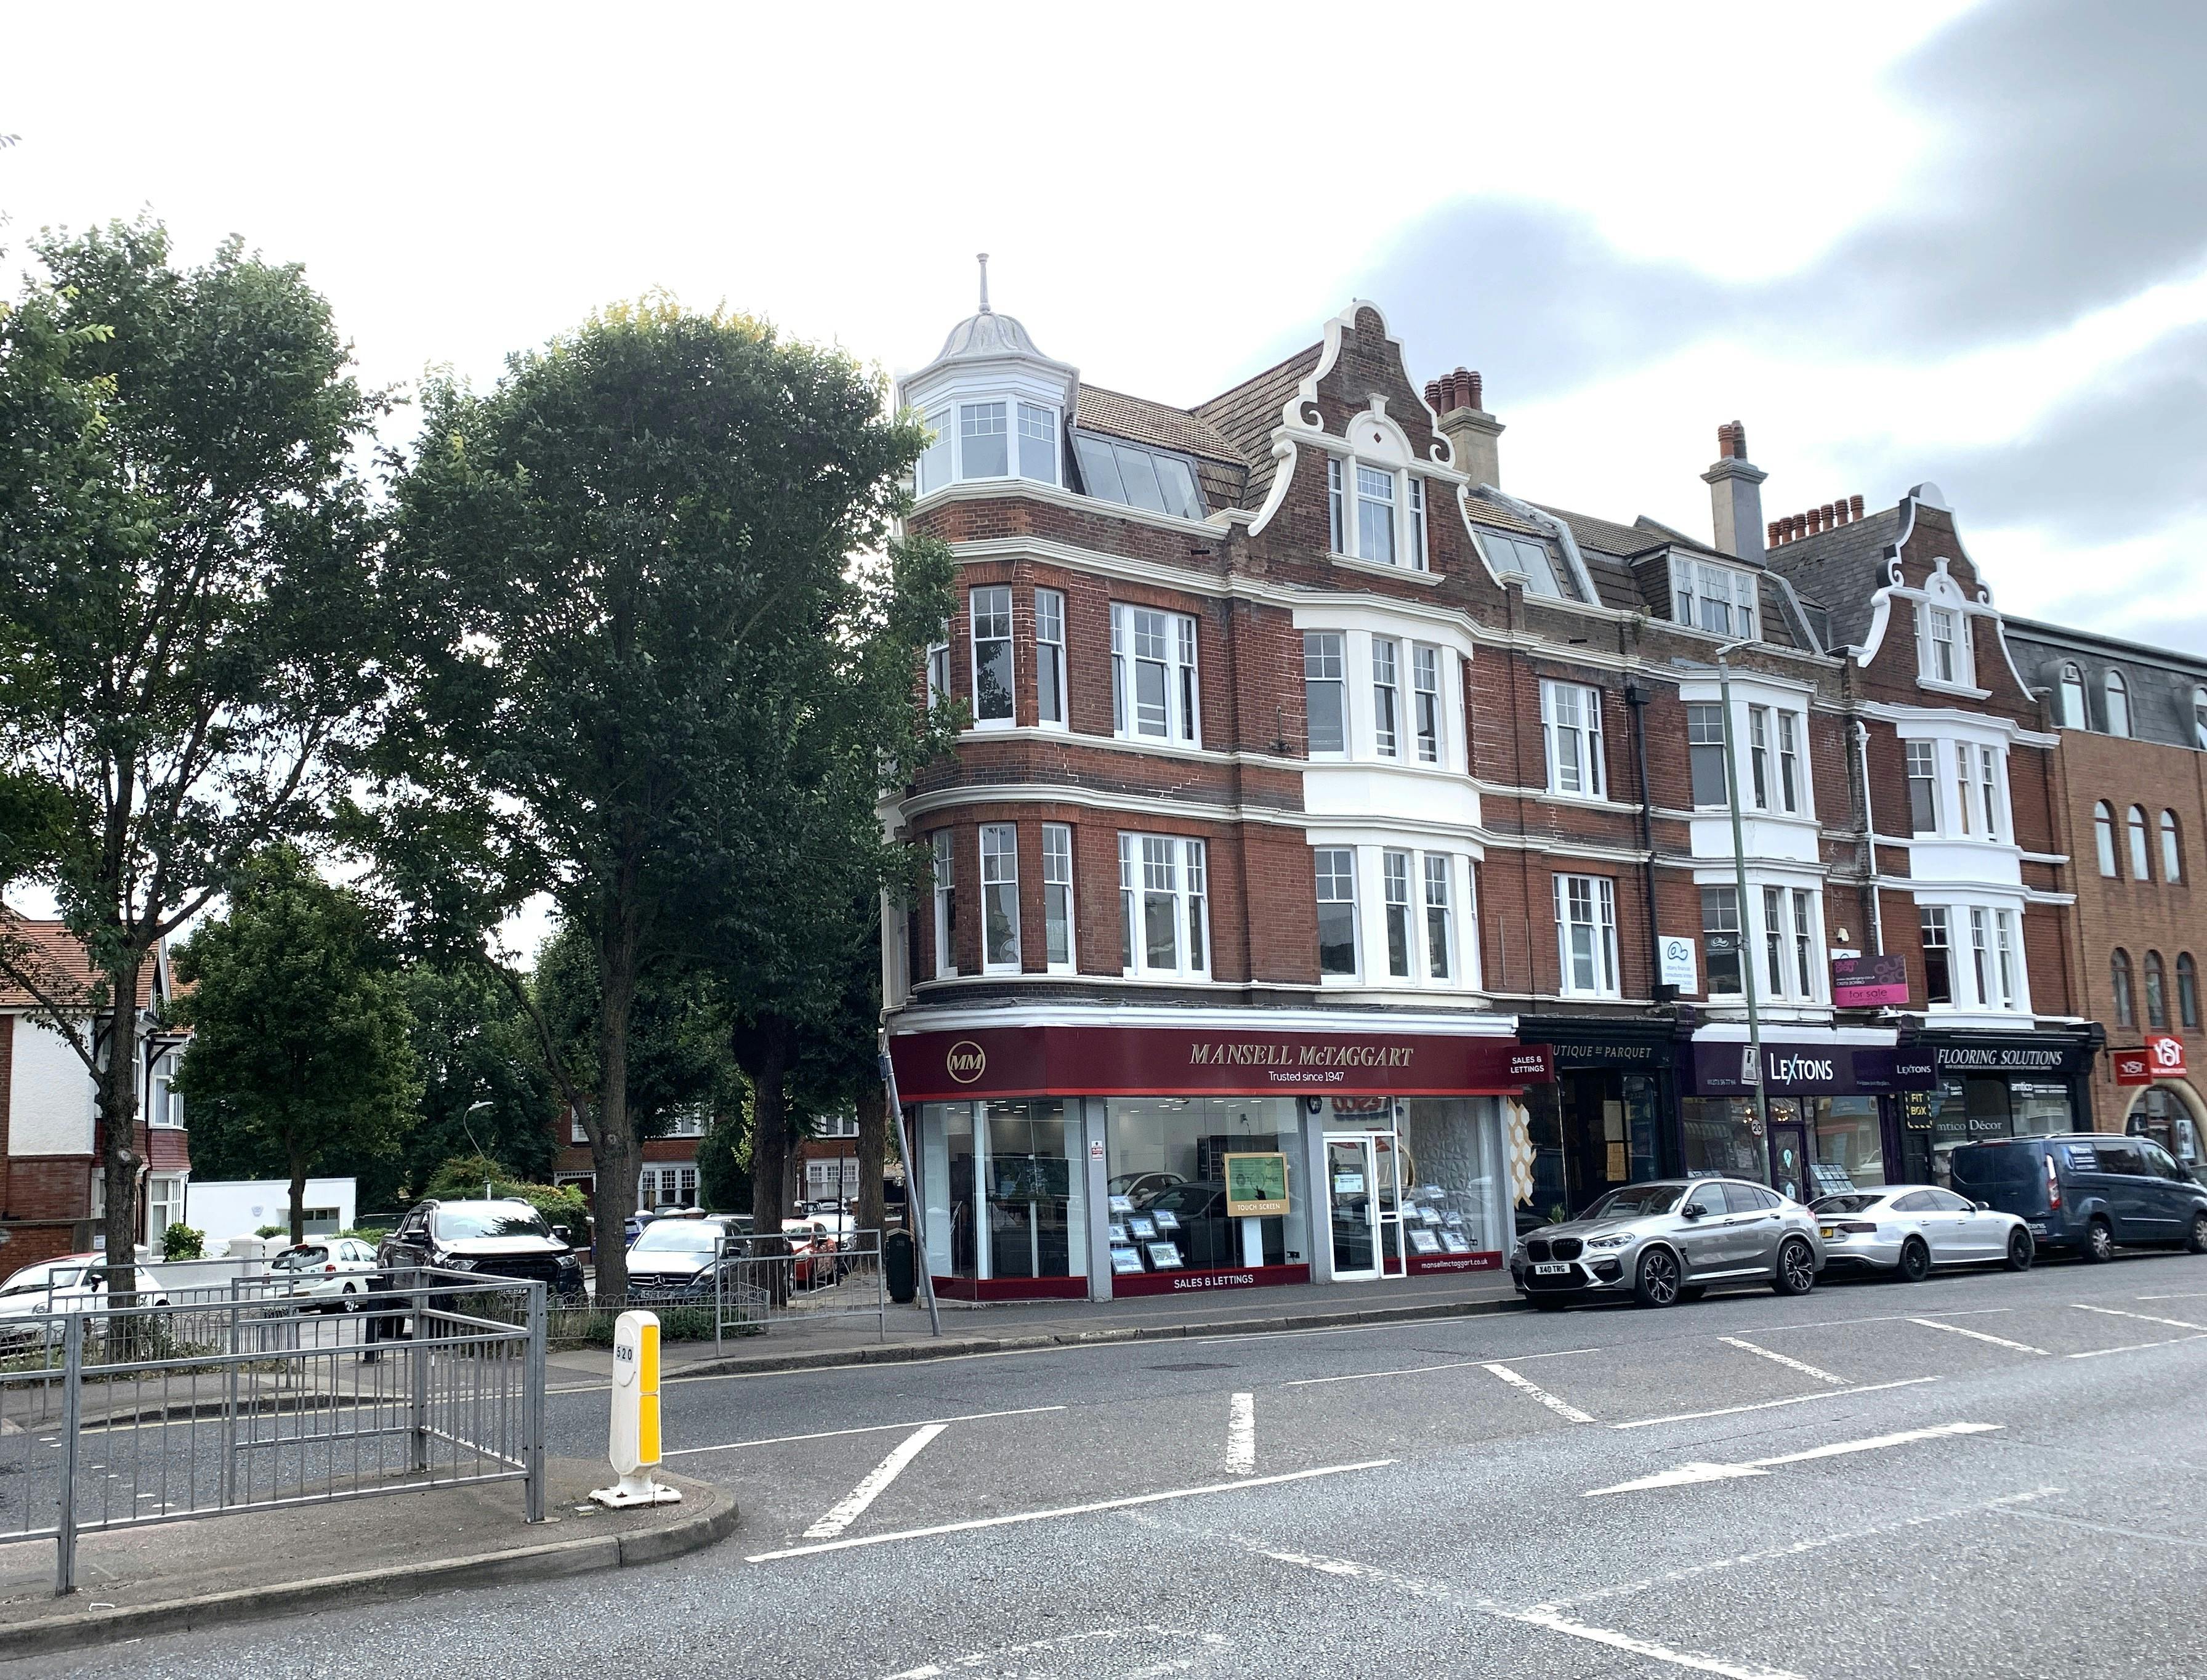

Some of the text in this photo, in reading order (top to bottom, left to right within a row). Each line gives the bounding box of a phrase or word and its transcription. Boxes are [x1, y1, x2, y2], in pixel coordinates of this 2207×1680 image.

[1849, 989, 1887, 998] for sale
[1189, 1044, 1414, 1067] MANSELL McTAGGART
[1552, 1045, 1593, 1058] UTIQUE
[1604, 1046, 1652, 1059] PARQUET
[1938, 1049, 2063, 1065] FLOORING SOLUTIONS
[950, 1054, 982, 1071] MM
[1512, 1056, 1535, 1065] SALES
[1511, 1065, 1544, 1073] LETTINGS
[1770, 1052, 1834, 1086] LEXTONS
[1897, 1064, 1932, 1075] LEXTONS
[1269, 1071, 1344, 1082] Trusted since 1947
[1911, 1093, 1924, 1102] FIT
[1911, 1106, 1927, 1115] BOX
[1753, 1123, 1762, 1133] 20
[1936, 1119, 2003, 1131] mtico Décor
[1421, 1258, 1488, 1269] mansellmctaggart.co.uk
[1552, 1265, 1565, 1273] TRG
[1174, 1274, 1254, 1288] SALES & LETTINGS
[617, 1346, 633, 1360] 520
